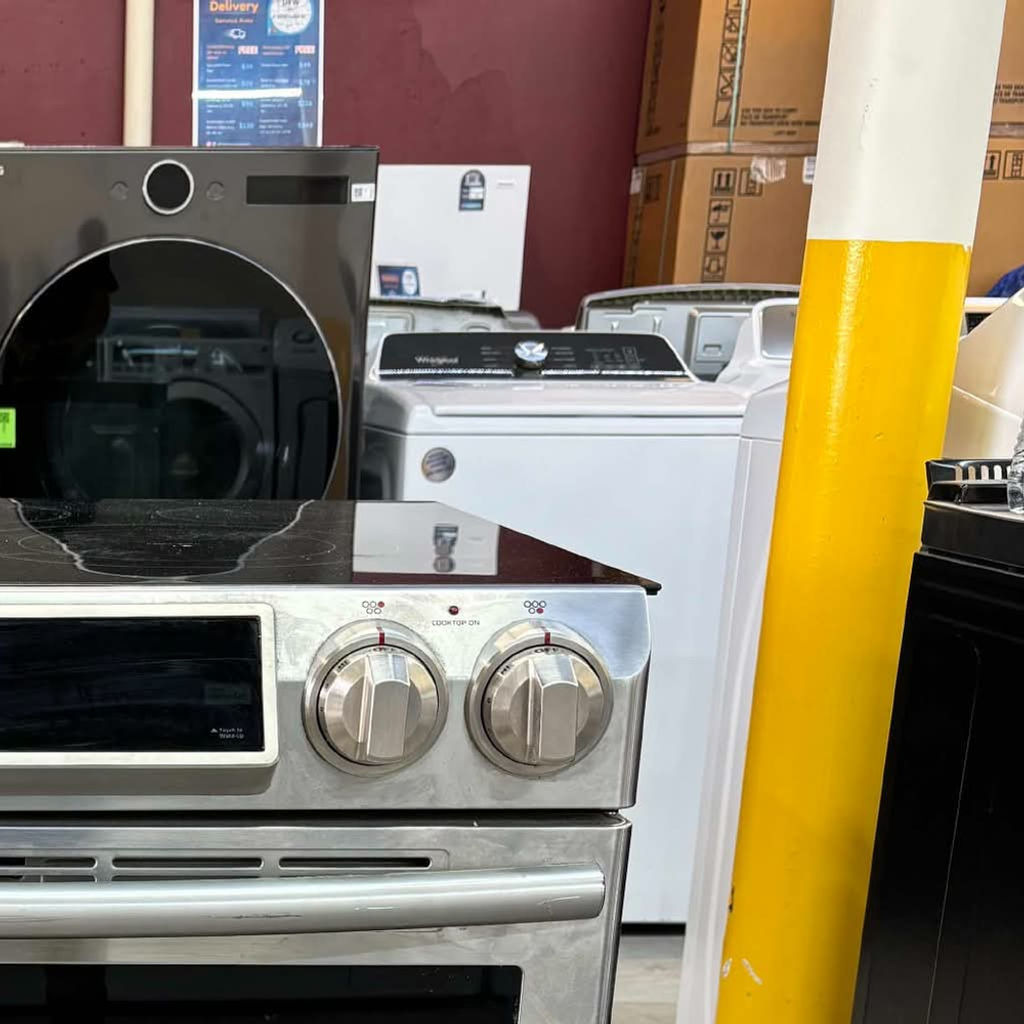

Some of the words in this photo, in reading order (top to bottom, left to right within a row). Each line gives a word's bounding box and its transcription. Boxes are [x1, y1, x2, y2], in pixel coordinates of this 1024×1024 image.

[209, 0, 259, 13] Delivery
[414, 355, 459, 367] Whirlpool
[431, 619, 467, 627] COOKTOP
[468, 619, 481, 627] ON
